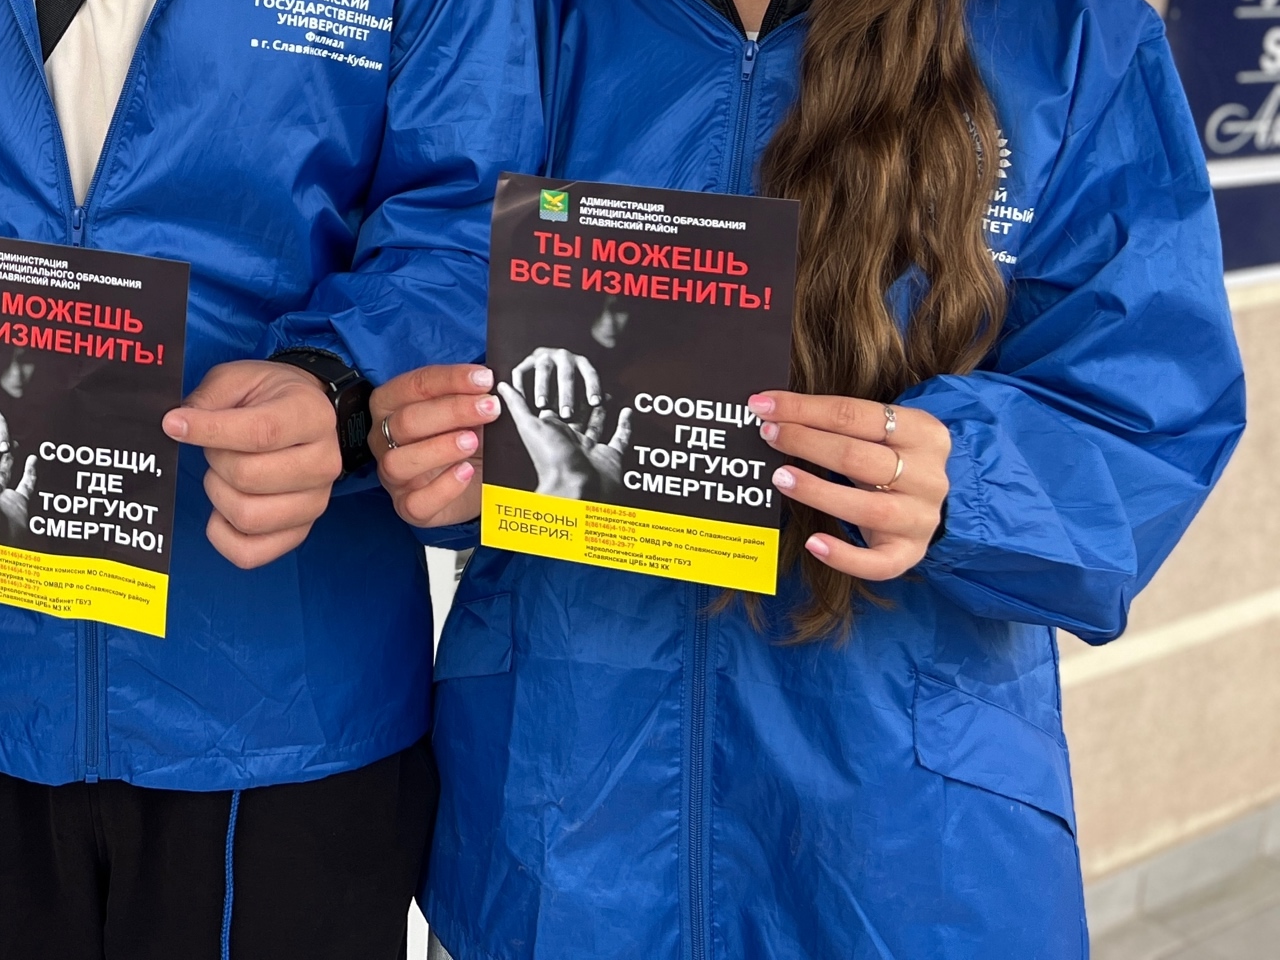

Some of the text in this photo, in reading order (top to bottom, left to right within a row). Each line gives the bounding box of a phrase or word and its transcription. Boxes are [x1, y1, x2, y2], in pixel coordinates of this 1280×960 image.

[277, 13, 370, 41] УНИВЕРСИТЕТ
[305, 31, 345, 49] Филиал
[251, 38, 383, 71] в г. Славянске-на-Кубани
[579, 196, 664, 213] АДМИНИСТРАЦИЯ
[579, 205, 746, 230] МУНИЦИПАЛЬНОГО ОБРАЗОВАНИЯ
[578, 215, 678, 234] СЛАВЯНСКИЙ РАЙОН
[533, 230, 748, 275] ТЫ МОЖЕШЬ
[49, 278, 80, 290] РАЙОН
[75, 271, 142, 289] ОБРАЗОВАНИЯ
[510, 258, 771, 310] ВСЕ ИЗМЕНИТЬ!
[1, 291, 143, 333] МОЖЕШЬ
[674, 424, 726, 450] ГДЕ
[38, 440, 162, 477] СООБЩИ,
[633, 445, 766, 479] ТОРГУЮТ
[75, 470, 123, 495] ГДЕ
[622, 470, 772, 508] СМЕРТЬЮ!
[38, 490, 158, 524] ТОРГУЮТ
[495, 503, 577, 527] ТЕЛЕФОНЫ
[28, 515, 163, 553] СМЕРТЬЮ!
[497, 518, 574, 541] ДОВЕРИЯ:
